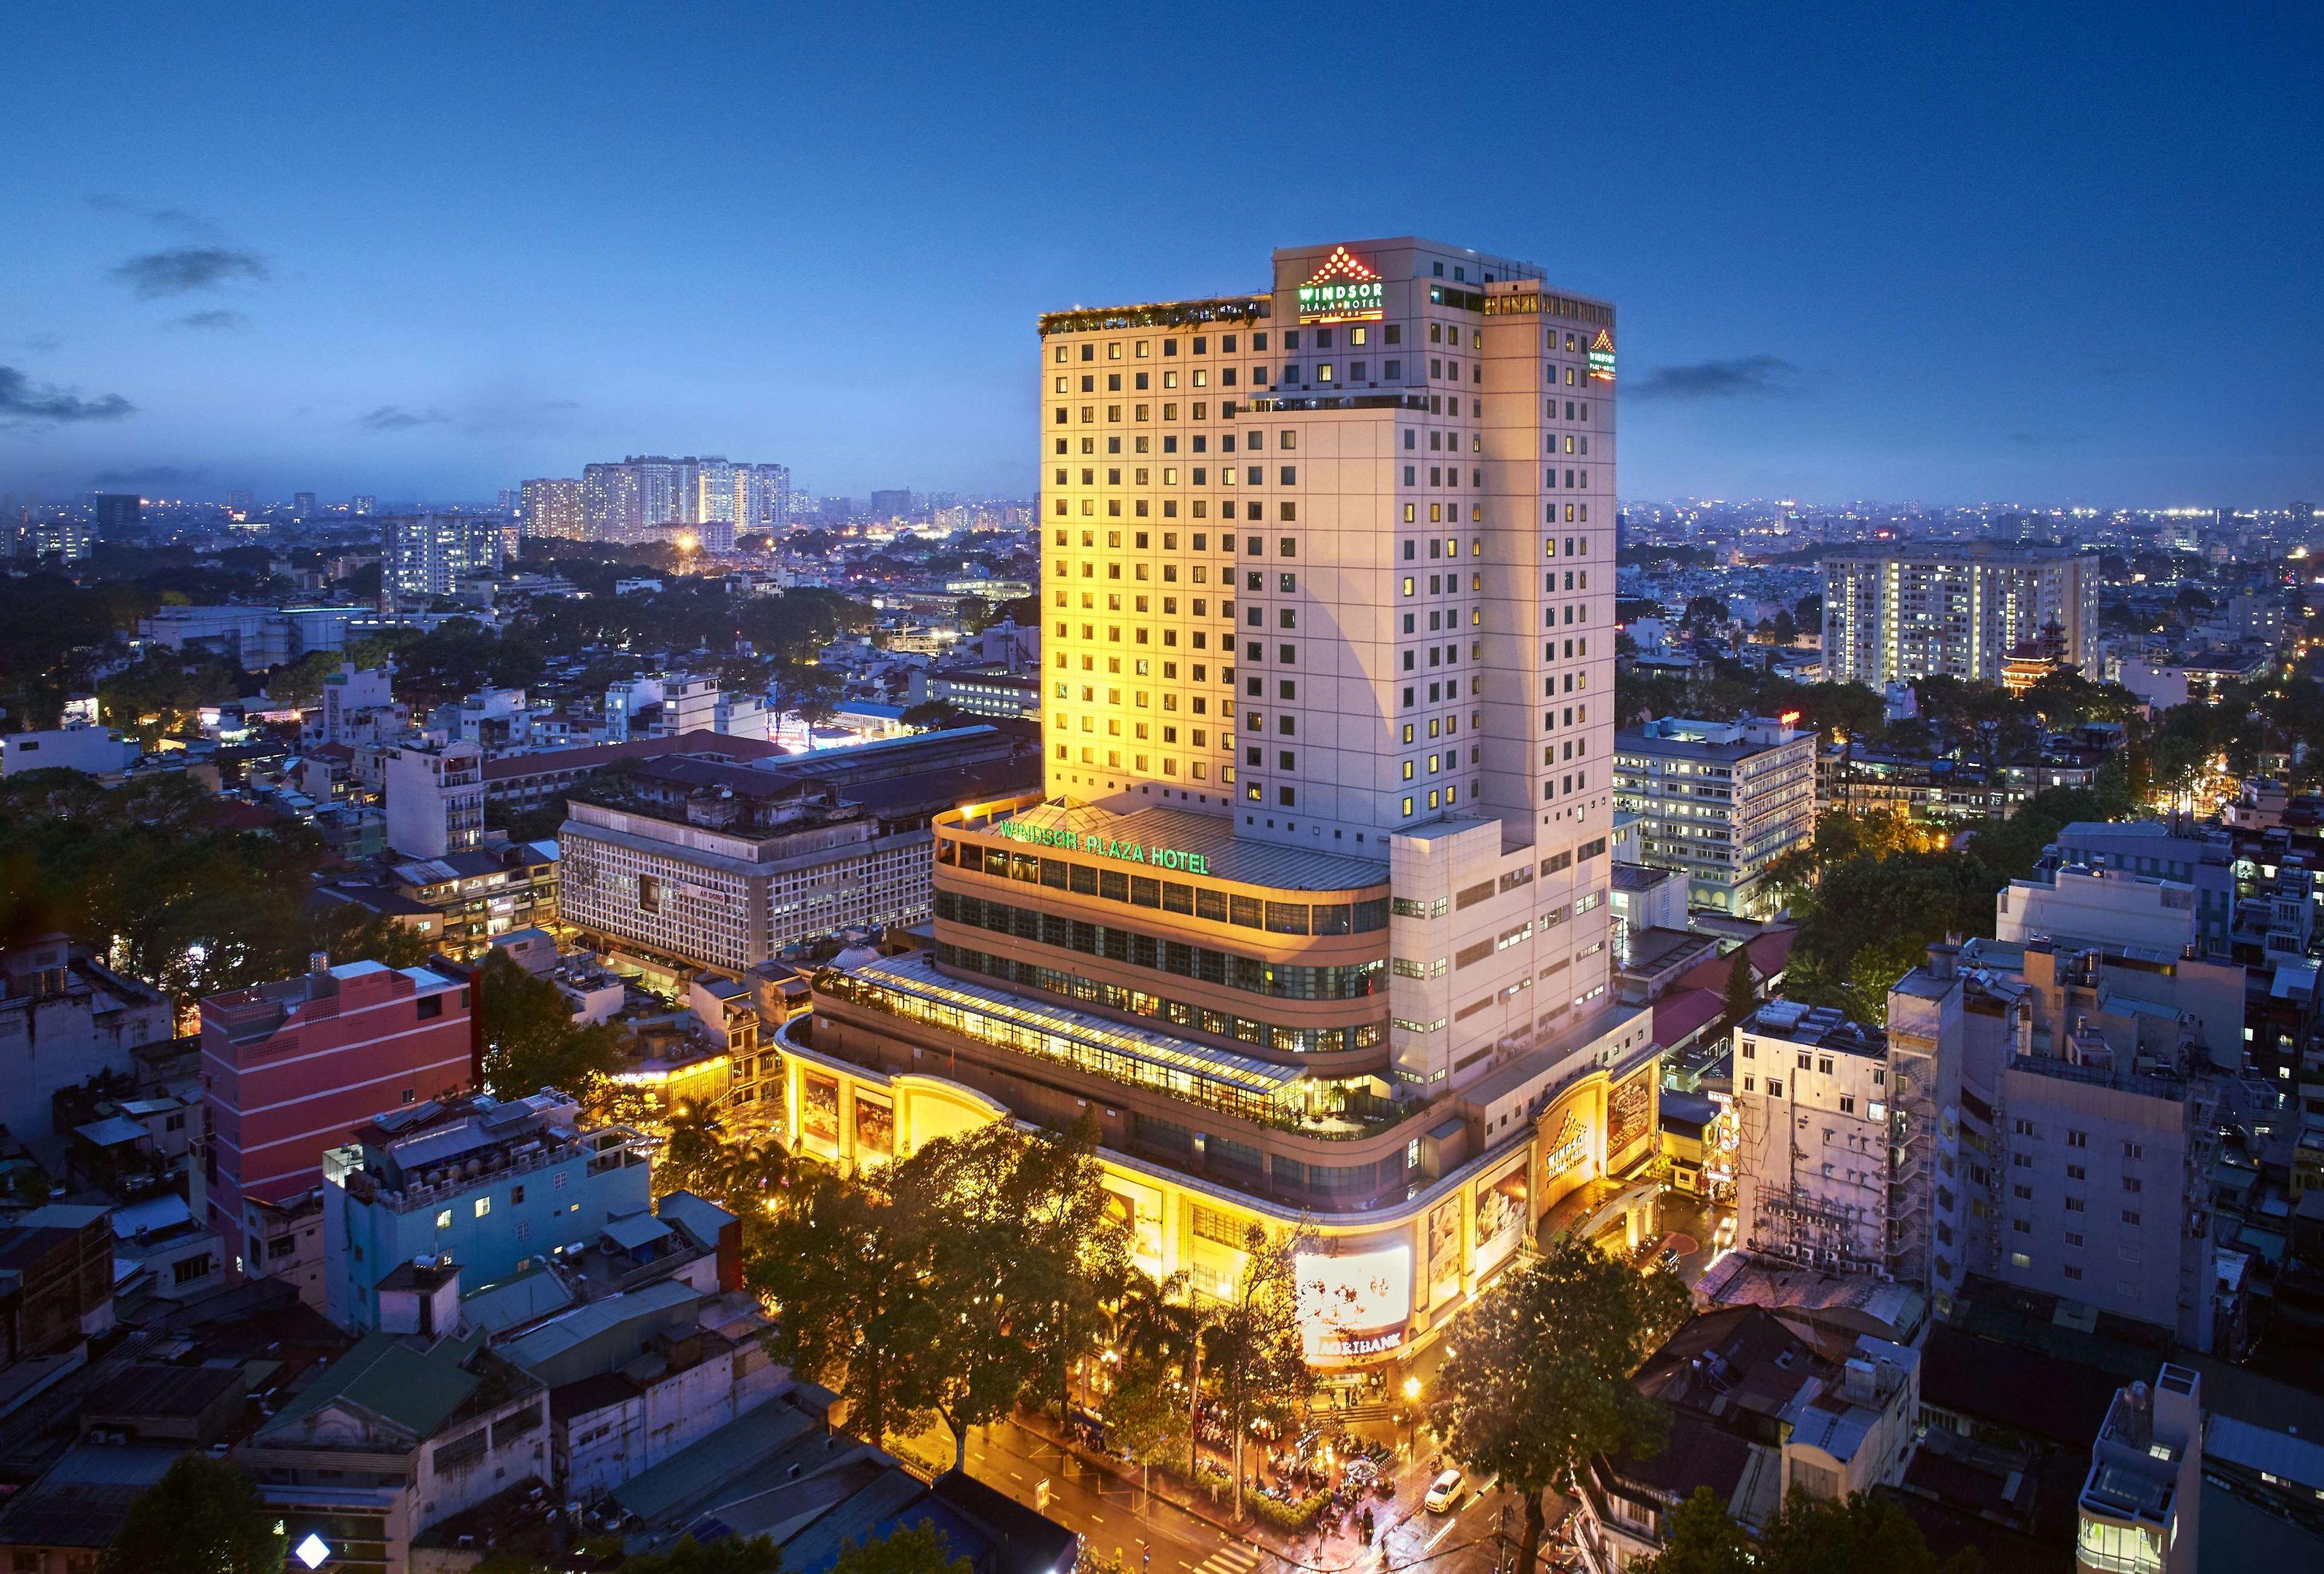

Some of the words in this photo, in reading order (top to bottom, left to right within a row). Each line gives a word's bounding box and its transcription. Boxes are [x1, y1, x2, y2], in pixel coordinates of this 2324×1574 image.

[1299, 283, 1382, 301] WINDSOR
[1299, 302, 1335, 313] PLAZA
[1343, 298, 1382, 309] HOTEL
[999, 820, 1078, 851] WINDSOR
[1087, 835, 1145, 863] PLAZA
[1151, 847, 1208, 874] HOTEL
